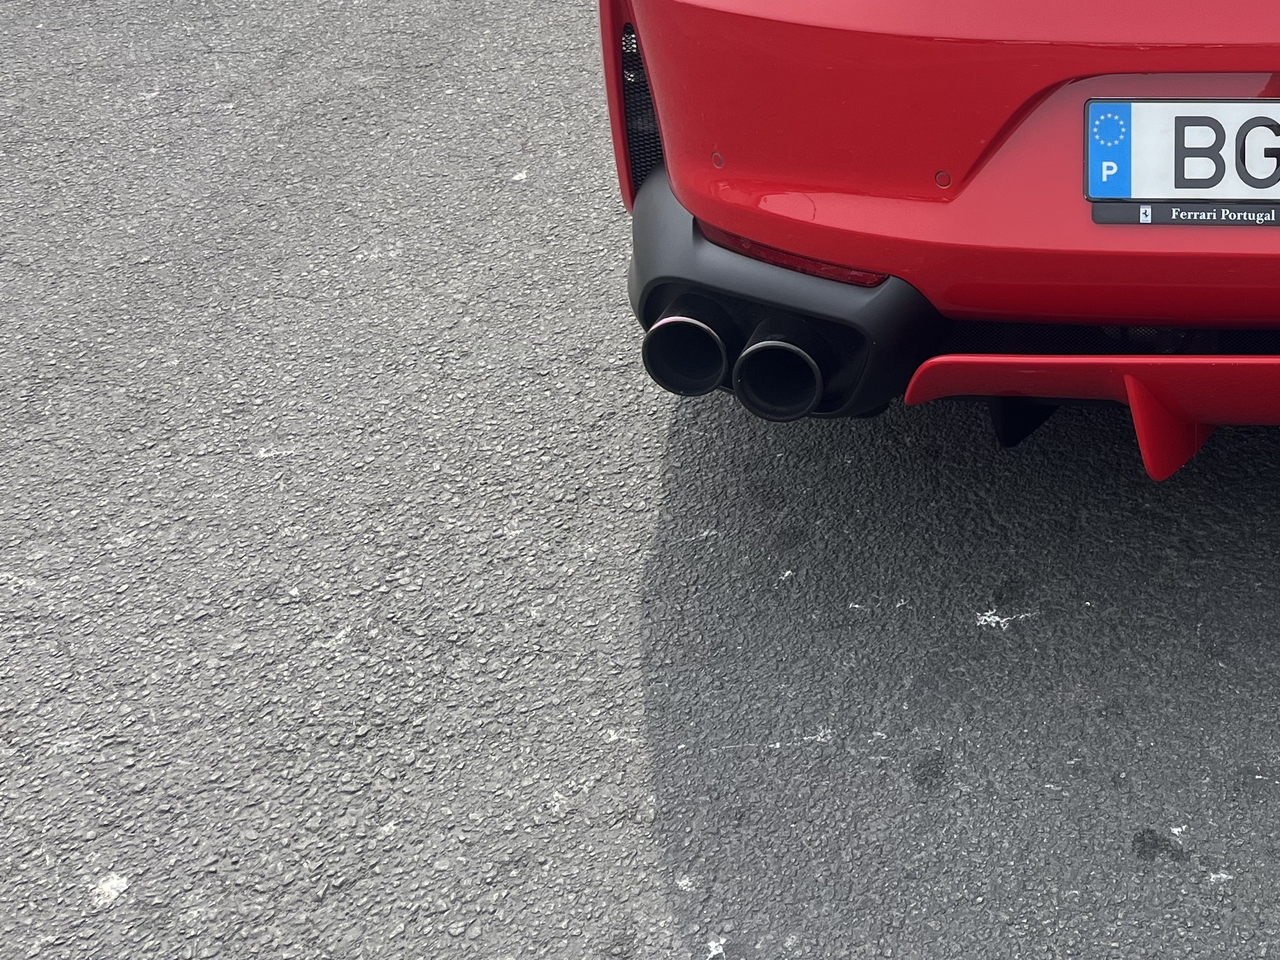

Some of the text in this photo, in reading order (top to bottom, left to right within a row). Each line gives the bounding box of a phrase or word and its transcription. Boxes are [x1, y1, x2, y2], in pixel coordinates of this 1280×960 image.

[1101, 161, 1118, 182] P
[1171, 208, 1275, 224] Ferrari Portugal
